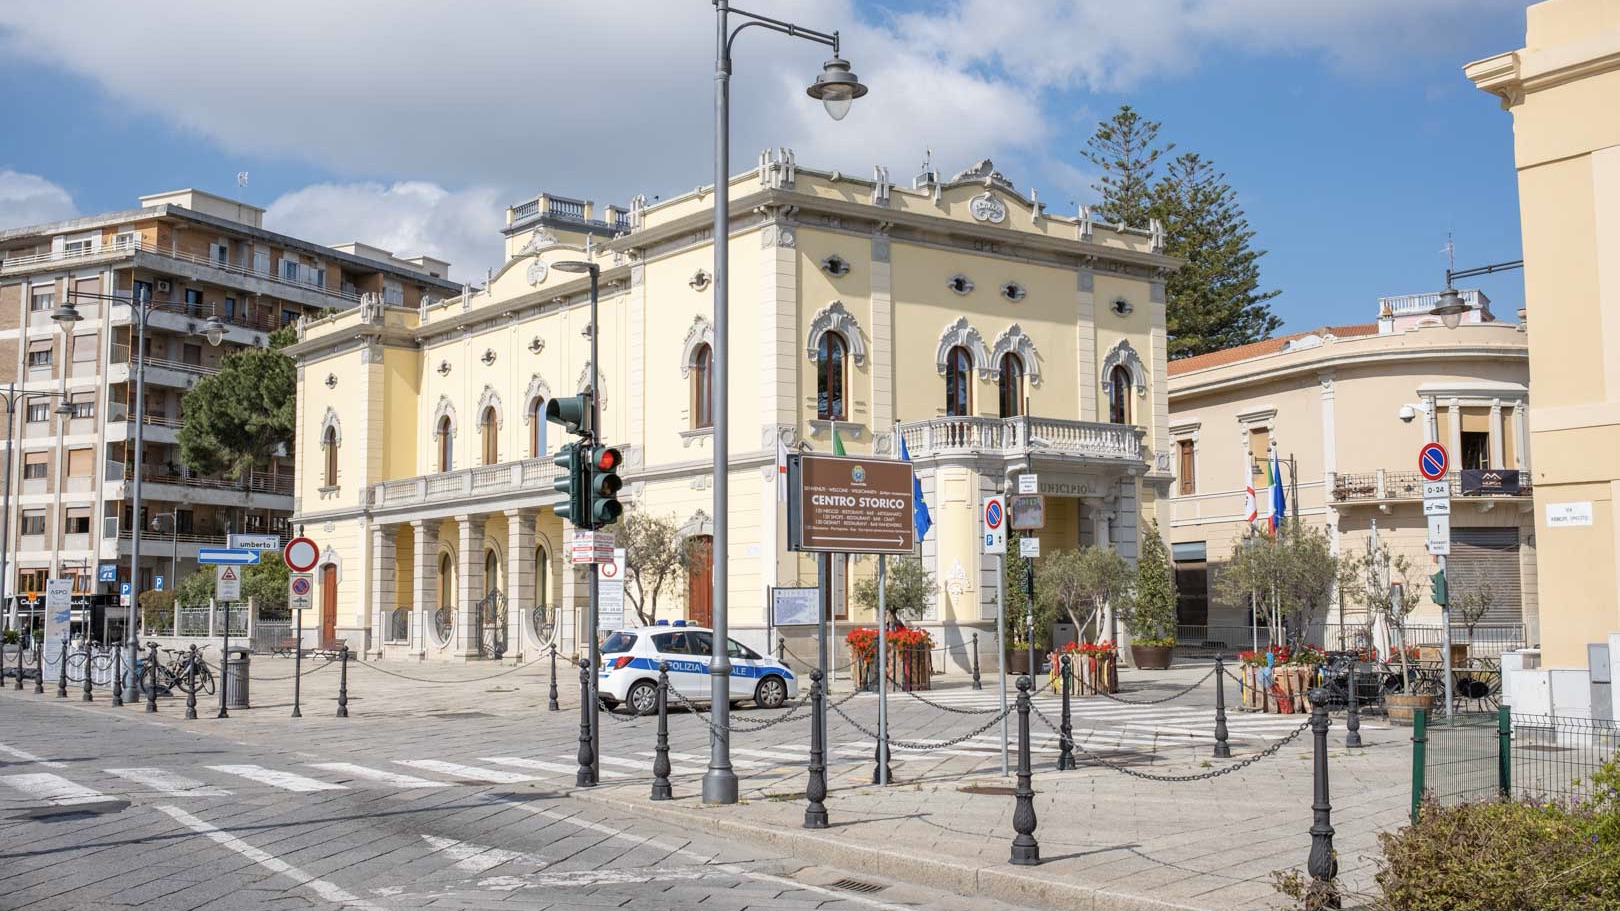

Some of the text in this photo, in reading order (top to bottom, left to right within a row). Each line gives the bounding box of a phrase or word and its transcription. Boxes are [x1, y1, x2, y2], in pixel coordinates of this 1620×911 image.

[1040, 482, 1088, 495] UNICIPIO
[1427, 486, 1445, 494] 0-24
[812, 495, 905, 509] CENTRO STORICO
[50, 588, 68, 596] ASPO
[668, 661, 700, 671] POLIZIA
